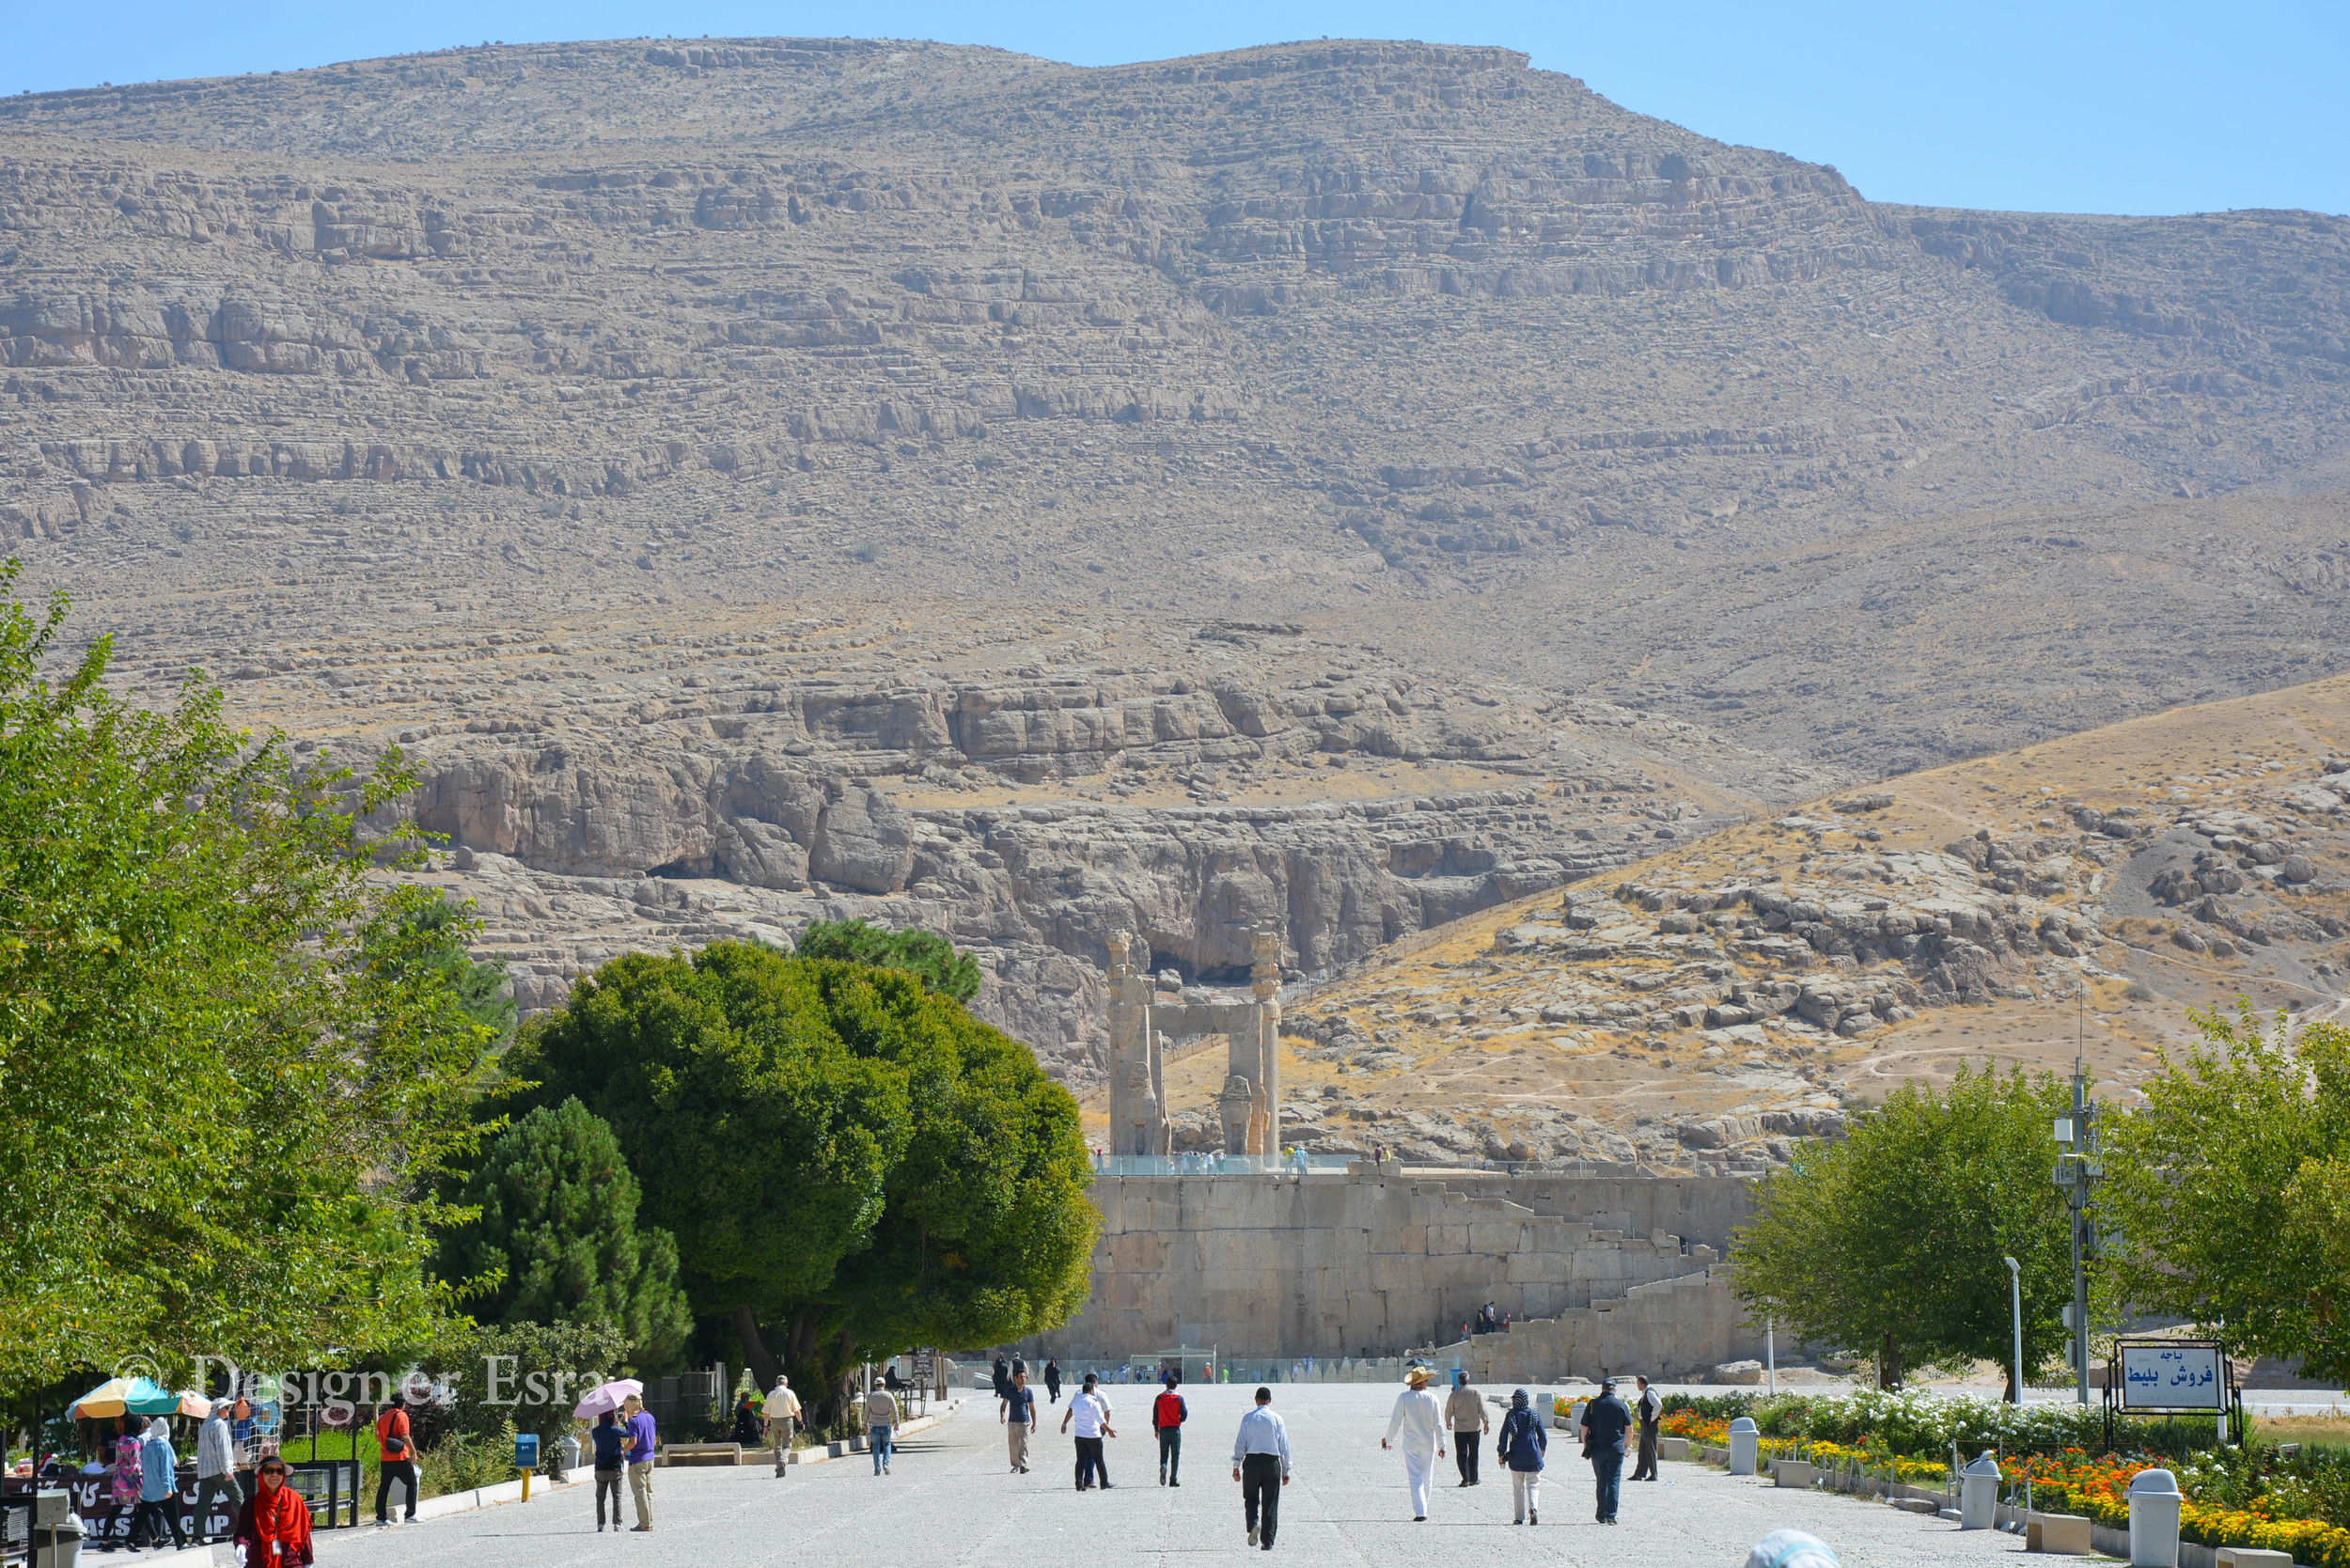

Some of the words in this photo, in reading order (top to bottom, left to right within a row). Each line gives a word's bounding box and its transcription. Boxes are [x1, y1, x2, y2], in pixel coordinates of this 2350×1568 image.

[2160, 1350, 2183, 1362] باجه
[2128, 1366, 2159, 1387] بلیط
[2170, 1365, 2213, 1387] فروش
